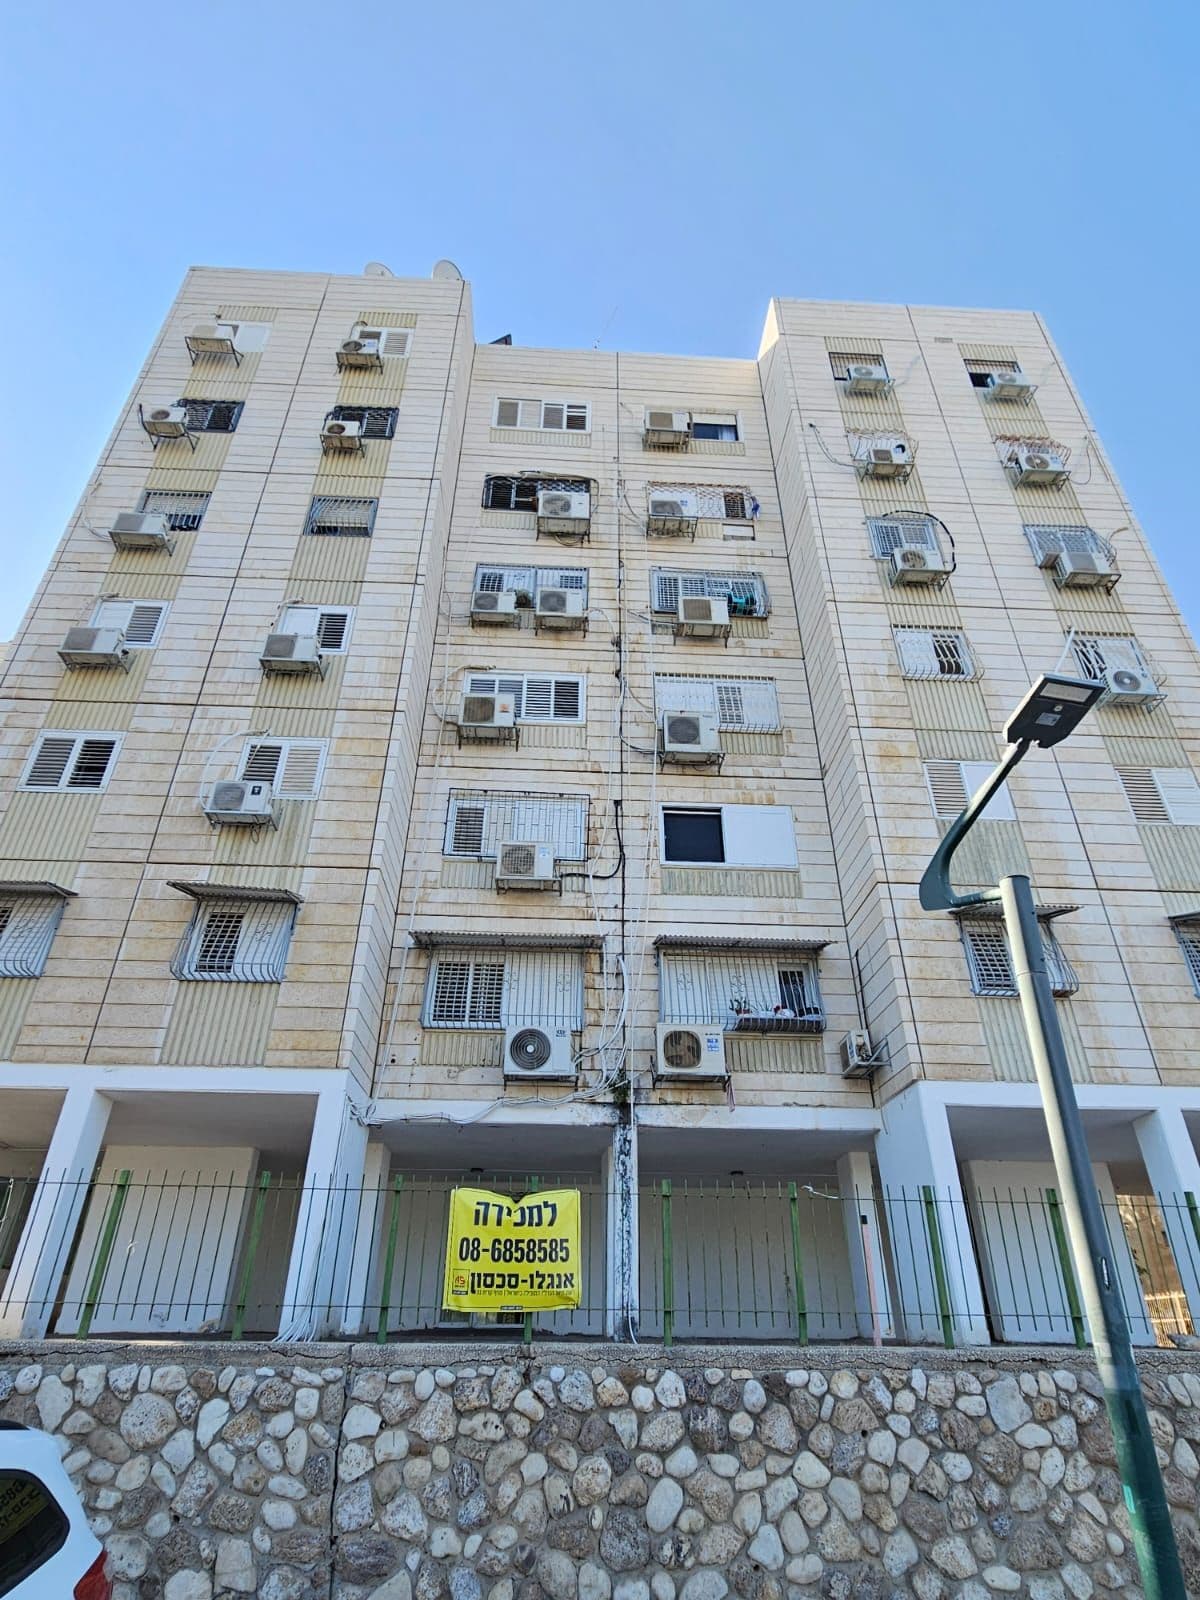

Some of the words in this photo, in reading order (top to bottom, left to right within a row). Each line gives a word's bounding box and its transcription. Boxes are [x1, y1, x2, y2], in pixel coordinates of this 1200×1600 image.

[474, 1200, 557, 1227] למכירה
[459, 1237, 569, 1263] 08-6858585
[470, 1270, 575, 1294] אנגלו-סכסון
